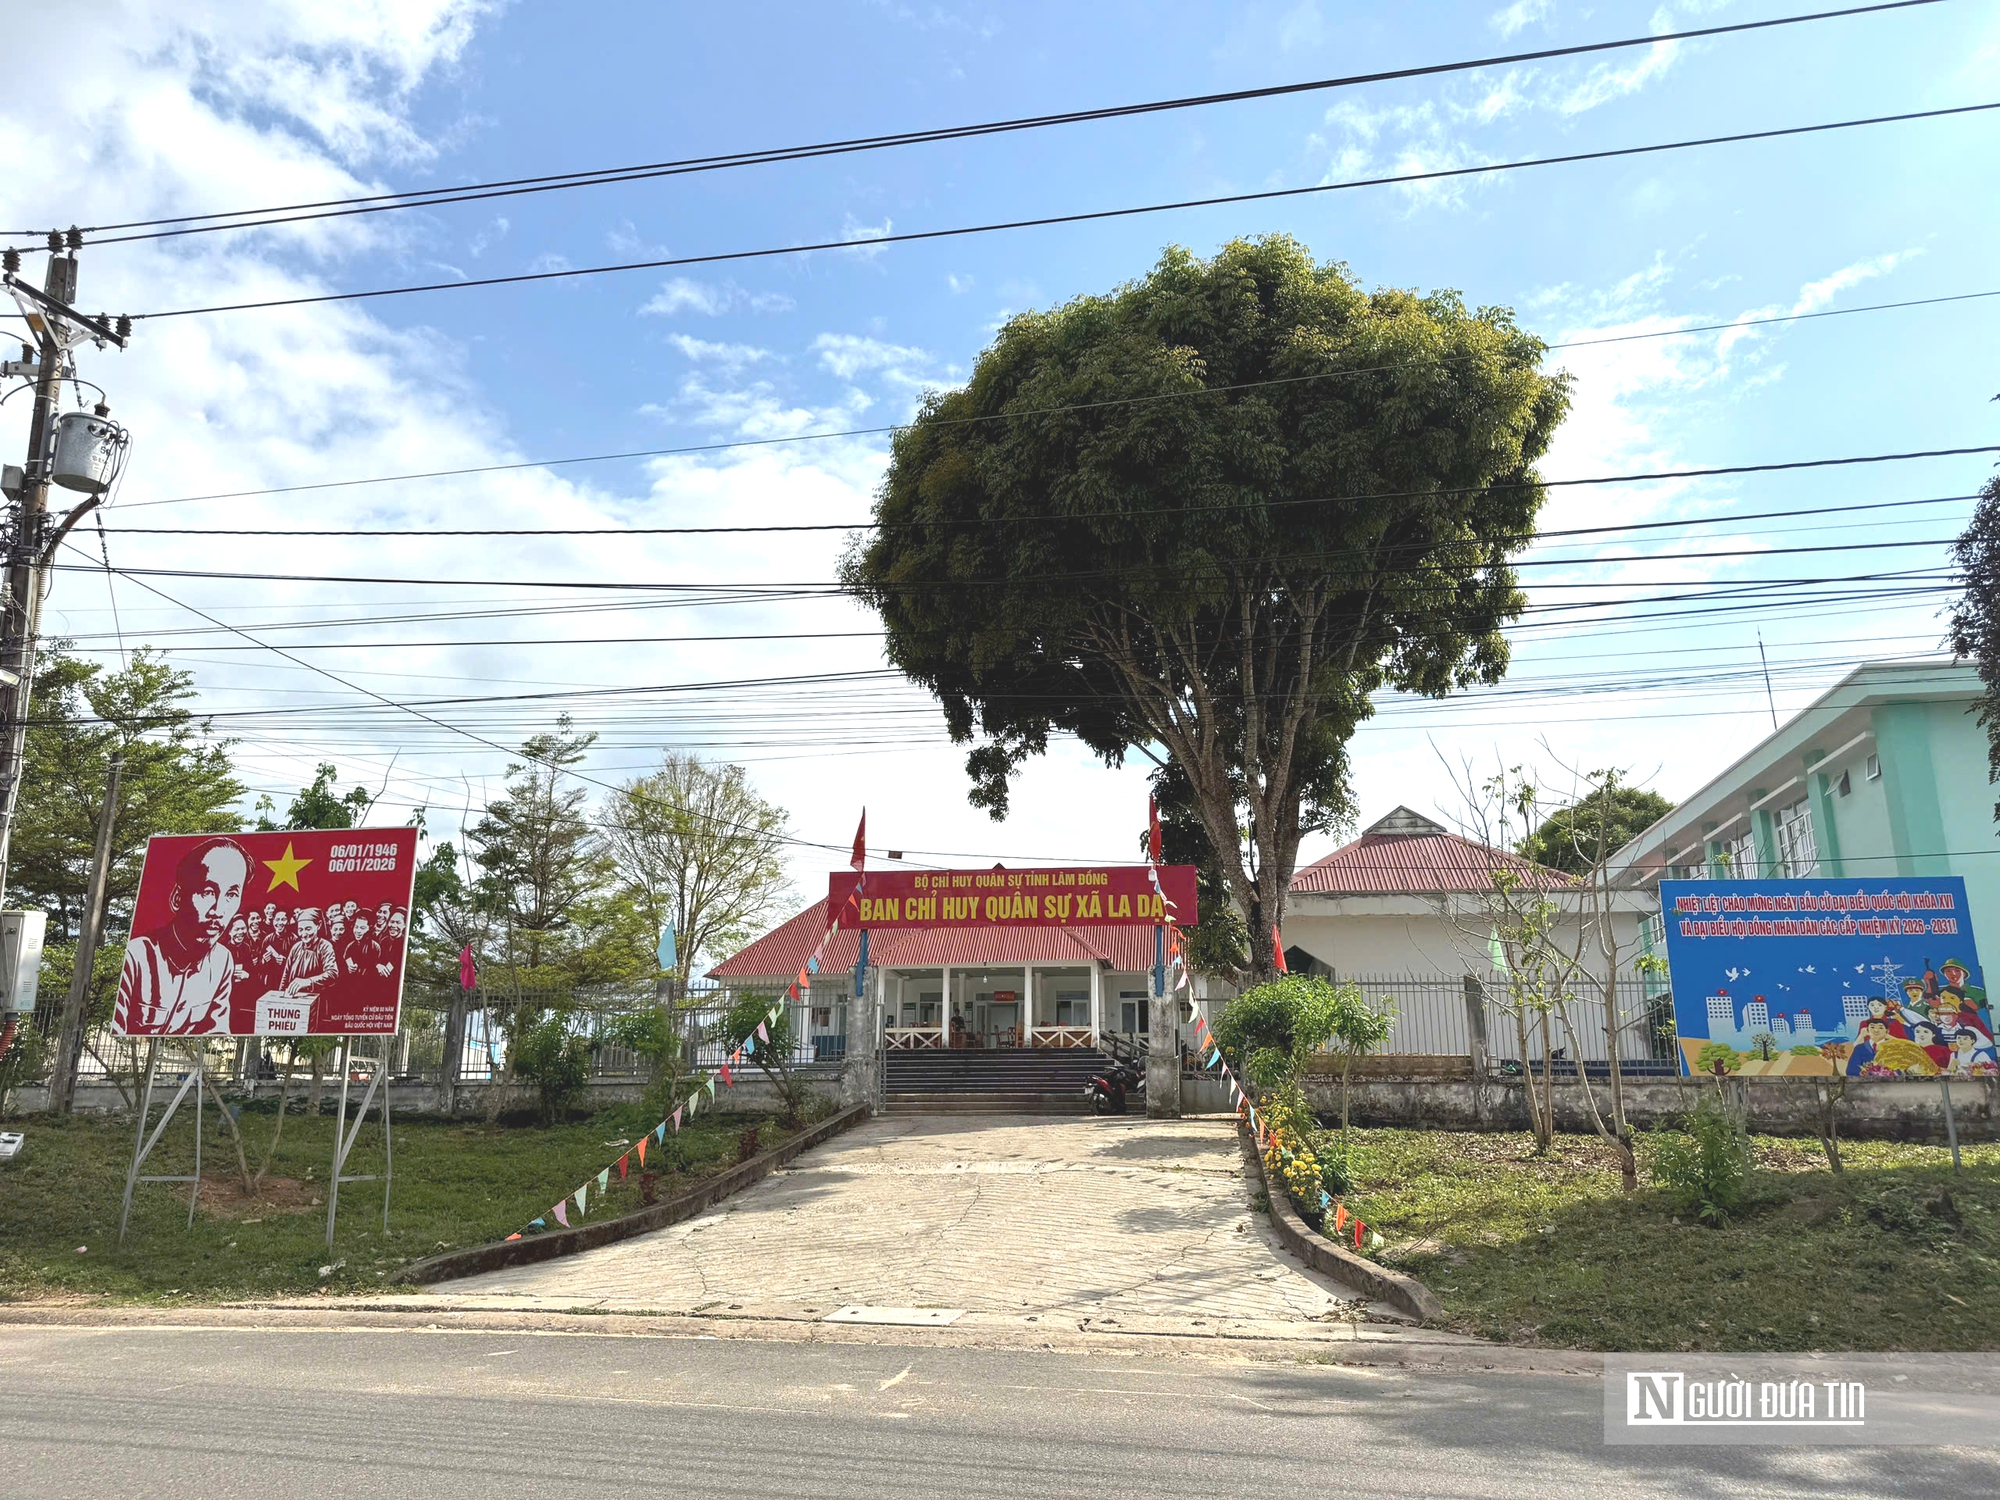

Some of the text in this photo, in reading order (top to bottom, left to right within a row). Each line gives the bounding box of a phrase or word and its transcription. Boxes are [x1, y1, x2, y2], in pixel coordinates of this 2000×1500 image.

[330, 843, 398, 858] 06/01/1946
[329, 858, 396, 872] 06/01/2026
[915, 869, 1108, 891] BỘ CHỈ HUY QUÂN SỰ TỈNH LÂM ĐỒNG
[860, 890, 1164, 923] BAN CHỈ HUY QUÂN SỰ XÃ LA DẠ
[1676, 894, 1702, 915] NHIỆT
[1703, 893, 1720, 915] LIỆT
[1721, 893, 1746, 911] CHÀO
[1746, 892, 1772, 912] MỪNG
[1773, 892, 1798, 911] NGÀY
[1832, 895, 1848, 914] ĐẠI
[1871, 889, 1895, 912] QUỐC
[1896, 891, 1912, 913] HỘI
[1912, 890, 1937, 910] KHÓA
[1938, 893, 1954, 910] XVI
[1680, 917, 1693, 936] VÀ
[1694, 920, 1708, 939] ĐẠI
[1731, 917, 1746, 939] HỘI
[1773, 917, 1798, 936] NHÂN
[1799, 916, 1819, 936] DÂN
[1819, 917, 1838, 935] CÁC
[1838, 915, 1857, 935] CẤP
[1858, 916, 1888, 938] NHIỆM
[1888, 916, 1901, 935] KỲ
[1902, 919, 1924, 934] 2026
[1931, 918, 1958, 934] 2031!
